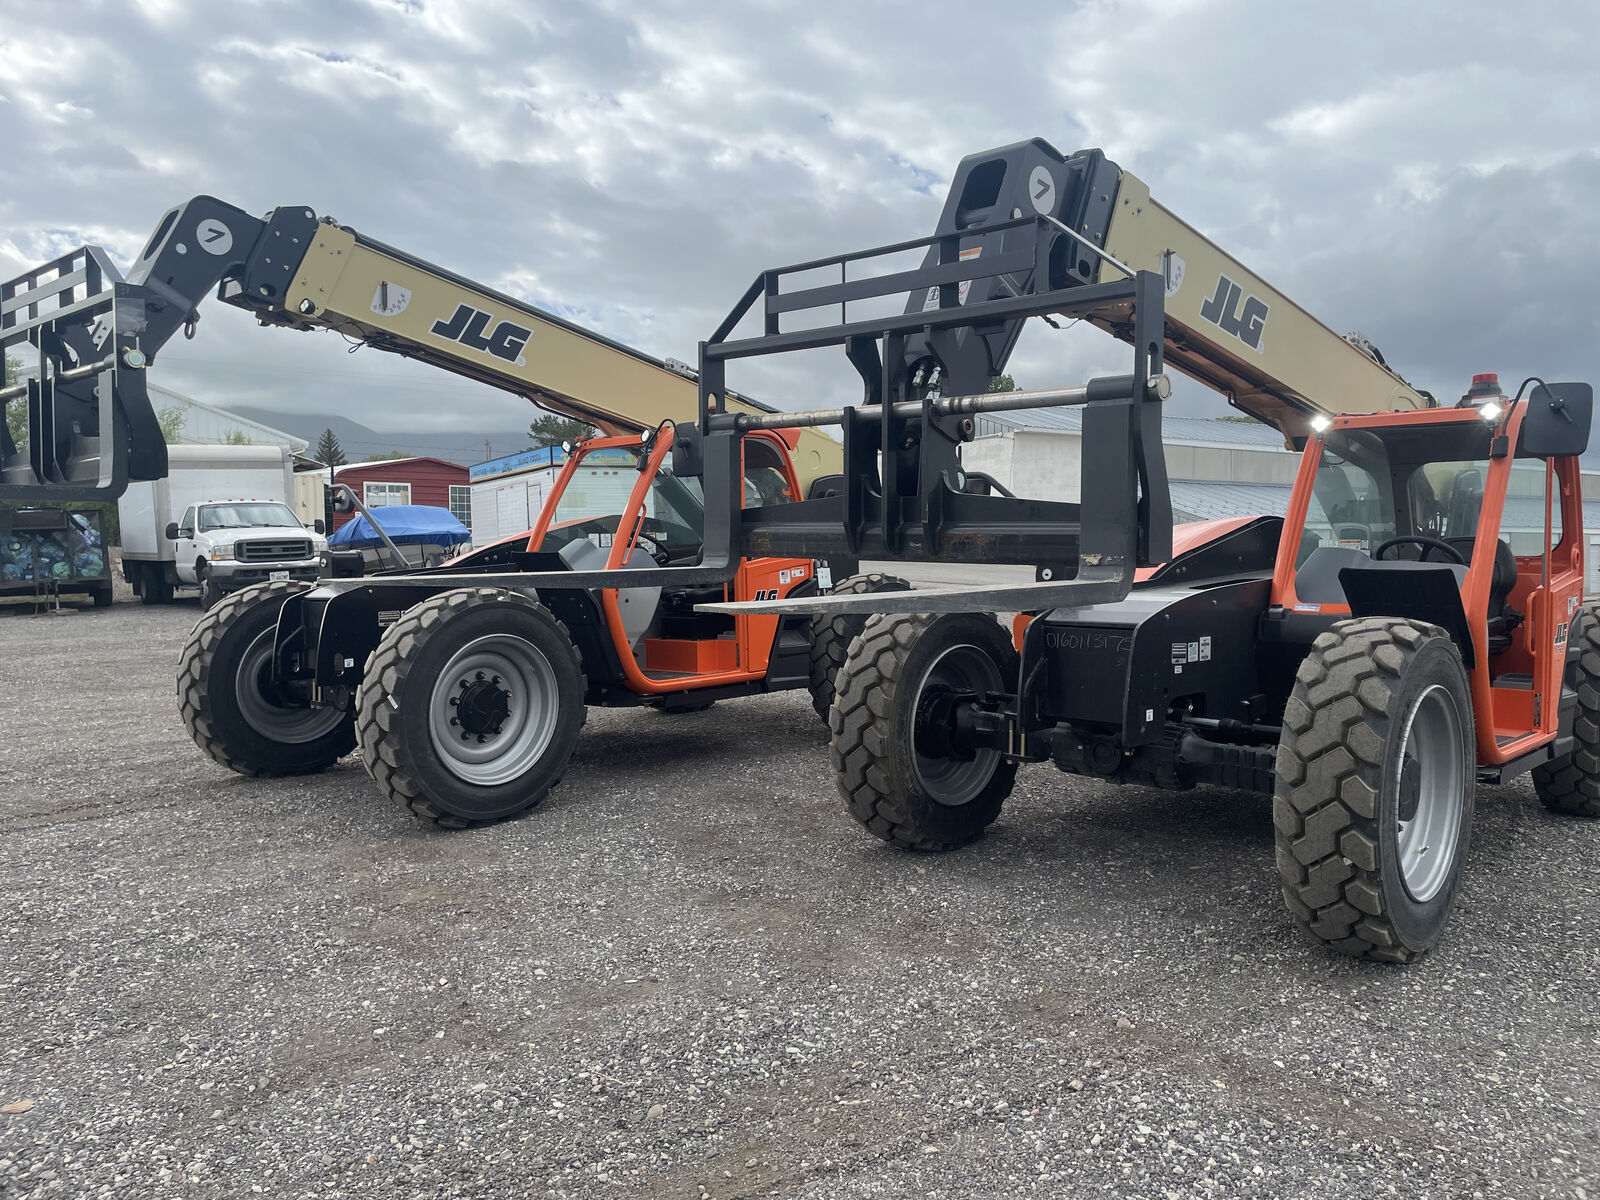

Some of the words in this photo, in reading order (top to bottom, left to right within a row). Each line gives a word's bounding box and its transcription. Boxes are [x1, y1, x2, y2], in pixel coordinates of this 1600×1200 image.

[429, 302, 534, 363] JLG
[1199, 272, 1270, 352] JLG
[1554, 622, 1568, 645] JLG
